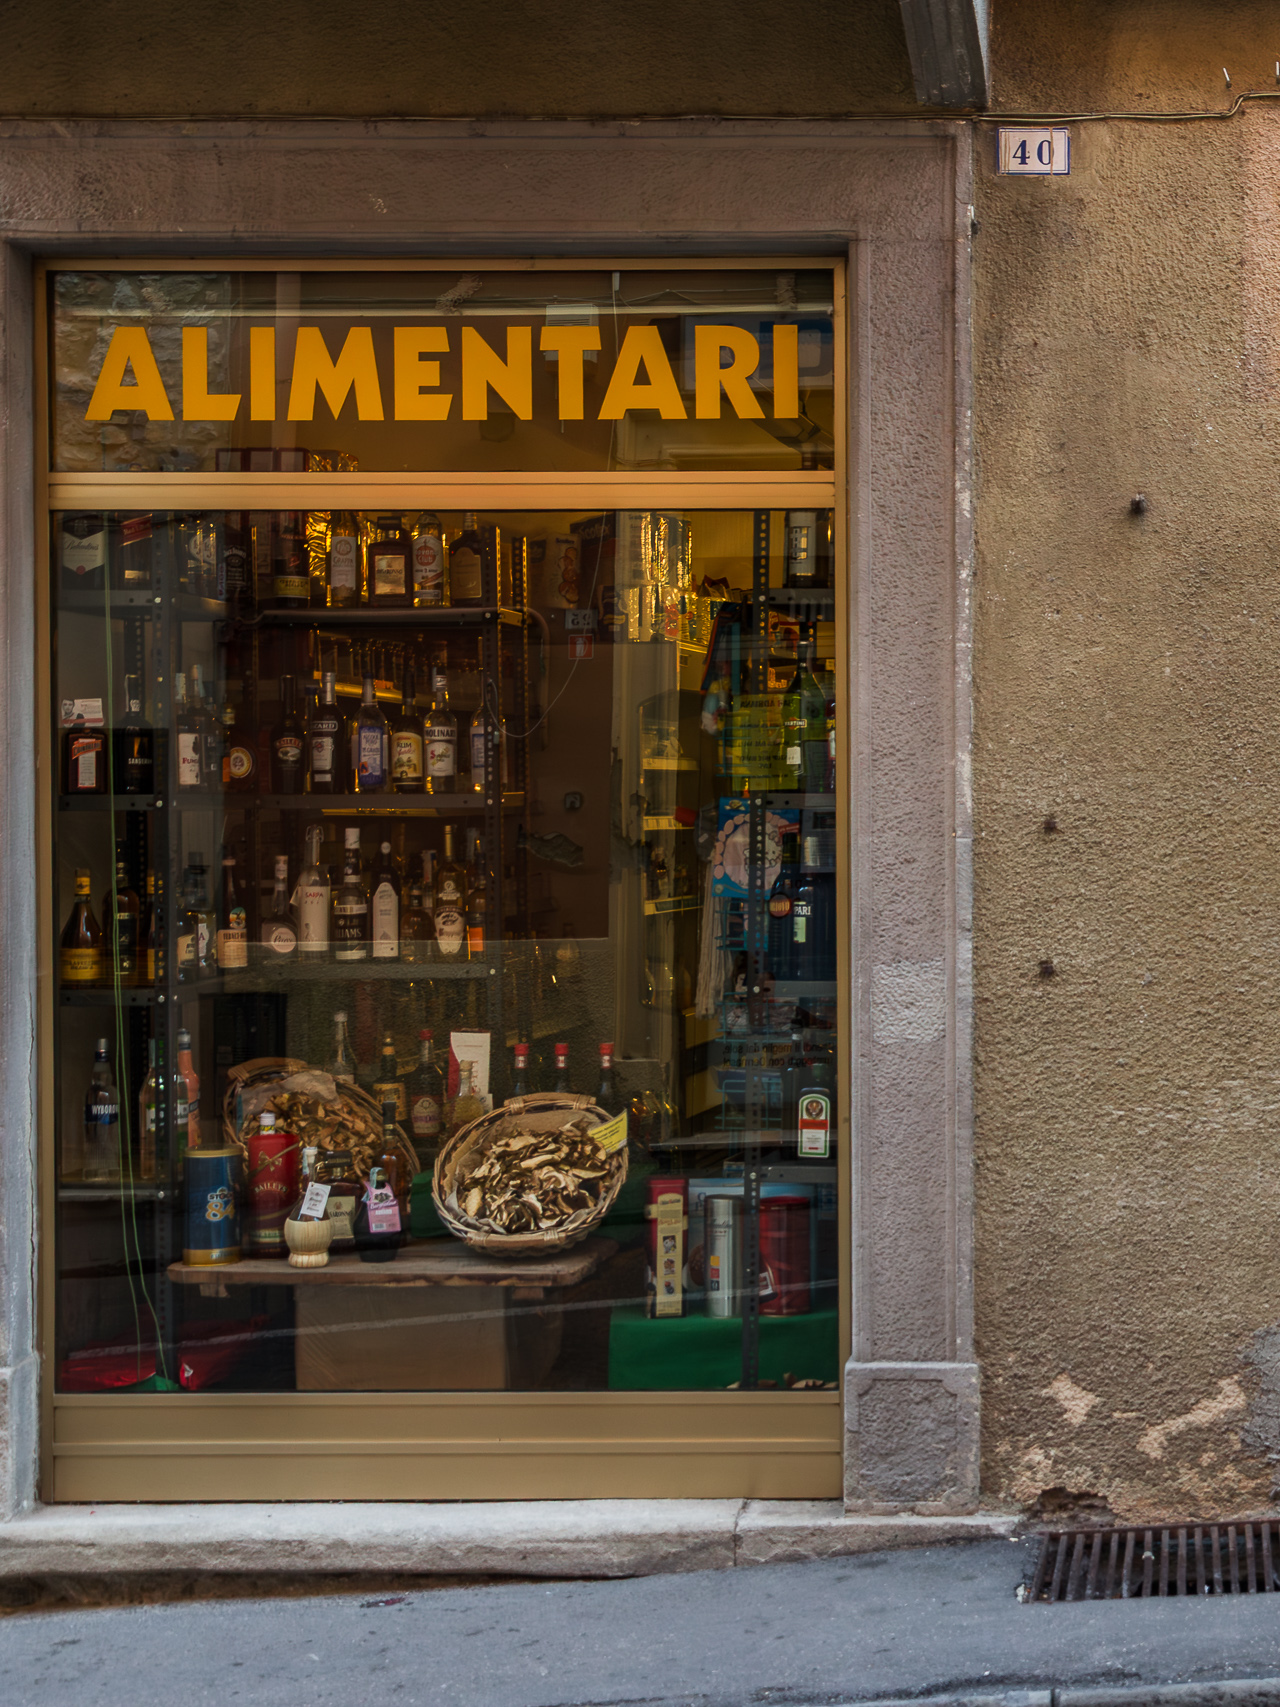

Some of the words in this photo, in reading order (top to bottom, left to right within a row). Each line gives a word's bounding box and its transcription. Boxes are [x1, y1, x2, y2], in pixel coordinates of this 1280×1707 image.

[1011, 139, 1052, 167] 40
[84, 325, 799, 421] ALIMENTARI
[254, 1182, 289, 1193] BAILEYS
[205, 1201, 235, 1221] 84
